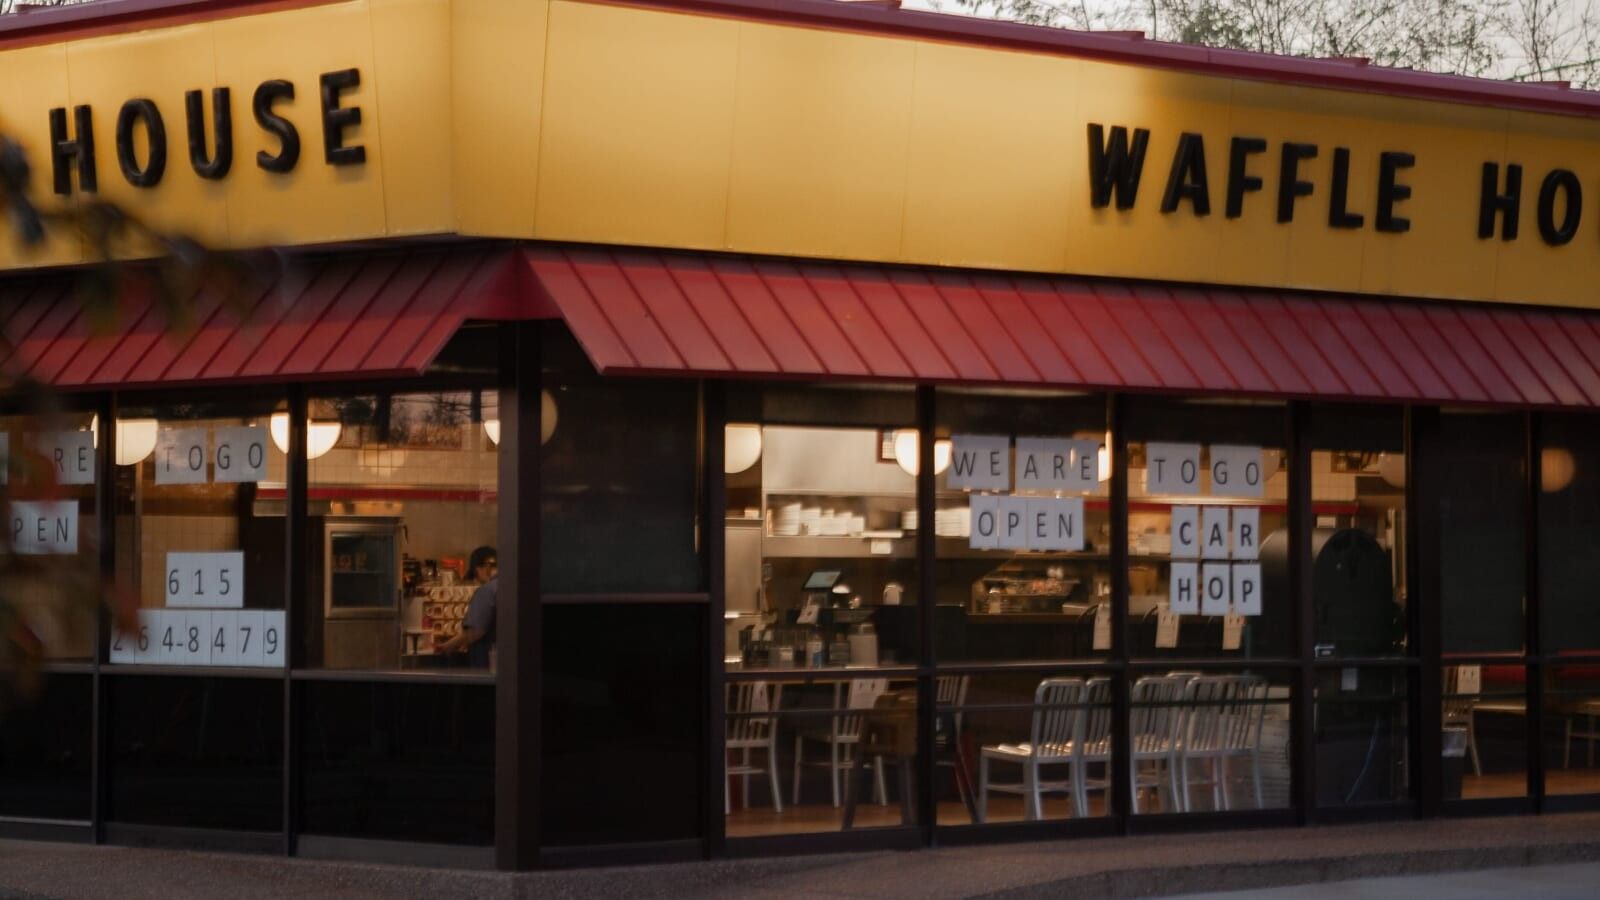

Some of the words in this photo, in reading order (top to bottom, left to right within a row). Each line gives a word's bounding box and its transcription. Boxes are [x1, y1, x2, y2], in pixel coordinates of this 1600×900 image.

[49, 68, 366, 194] HOUSE
[1087, 123, 1415, 232] WAFFLE
[1478, 162, 1600, 246] HO
[54, 445, 89, 473] RE
[952, 451, 1001, 476] WE
[1023, 455, 1092, 481] ARE
[14, 516, 69, 543] PEN
[978, 511, 1073, 538] OPEN
[1179, 522, 1252, 546] CAR
[1178, 577, 1253, 603] HOP
